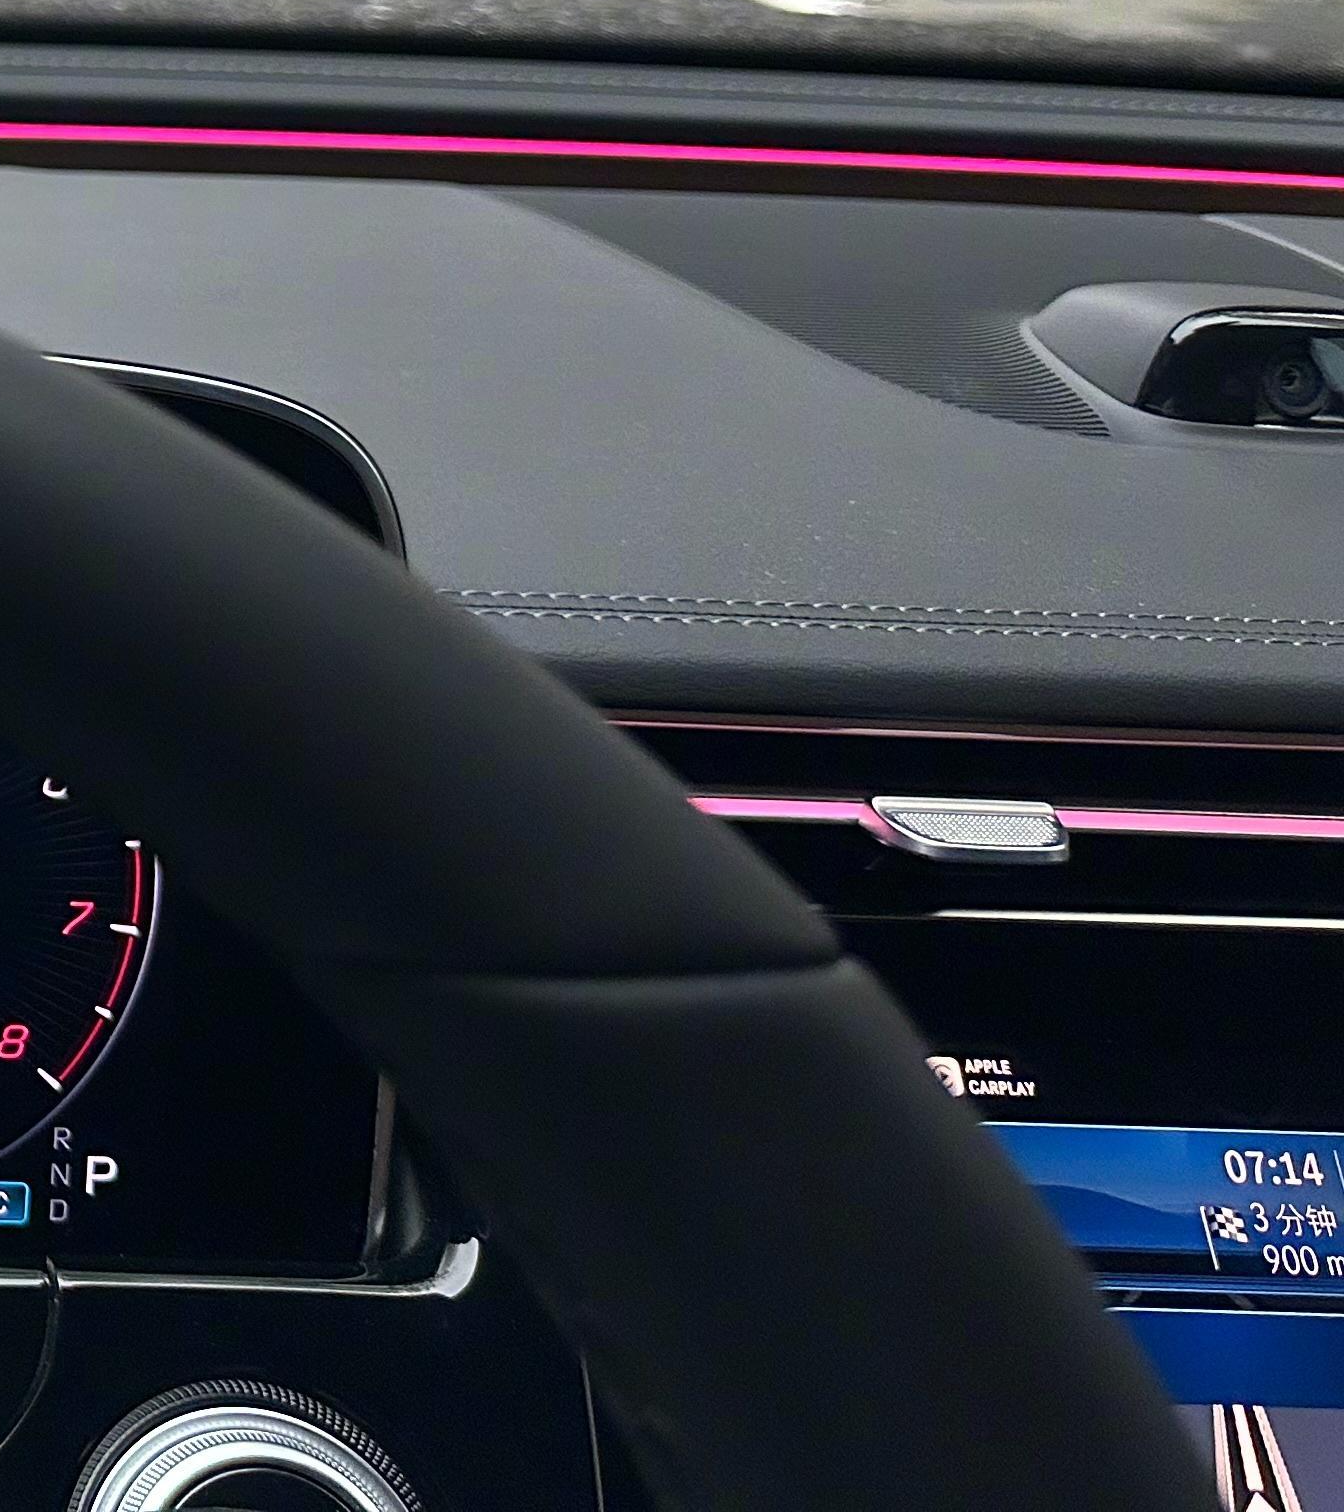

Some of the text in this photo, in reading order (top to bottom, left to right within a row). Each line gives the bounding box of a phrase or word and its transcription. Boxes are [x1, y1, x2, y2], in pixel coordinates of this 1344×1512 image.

[63, 901, 94, 934] 7
[964, 1059, 1012, 1076] APPLE
[969, 1080, 1035, 1096] CARPLAY
[54, 1127, 71, 1149] R
[51, 1163, 69, 1185] N
[86, 1156, 117, 1195] P
[1224, 1149, 1324, 1186] 07:14
[50, 1199, 67, 1221] D
[1250, 1202, 1337, 1237] 3 分钟
[1263, 1244, 1319, 1276] 900
